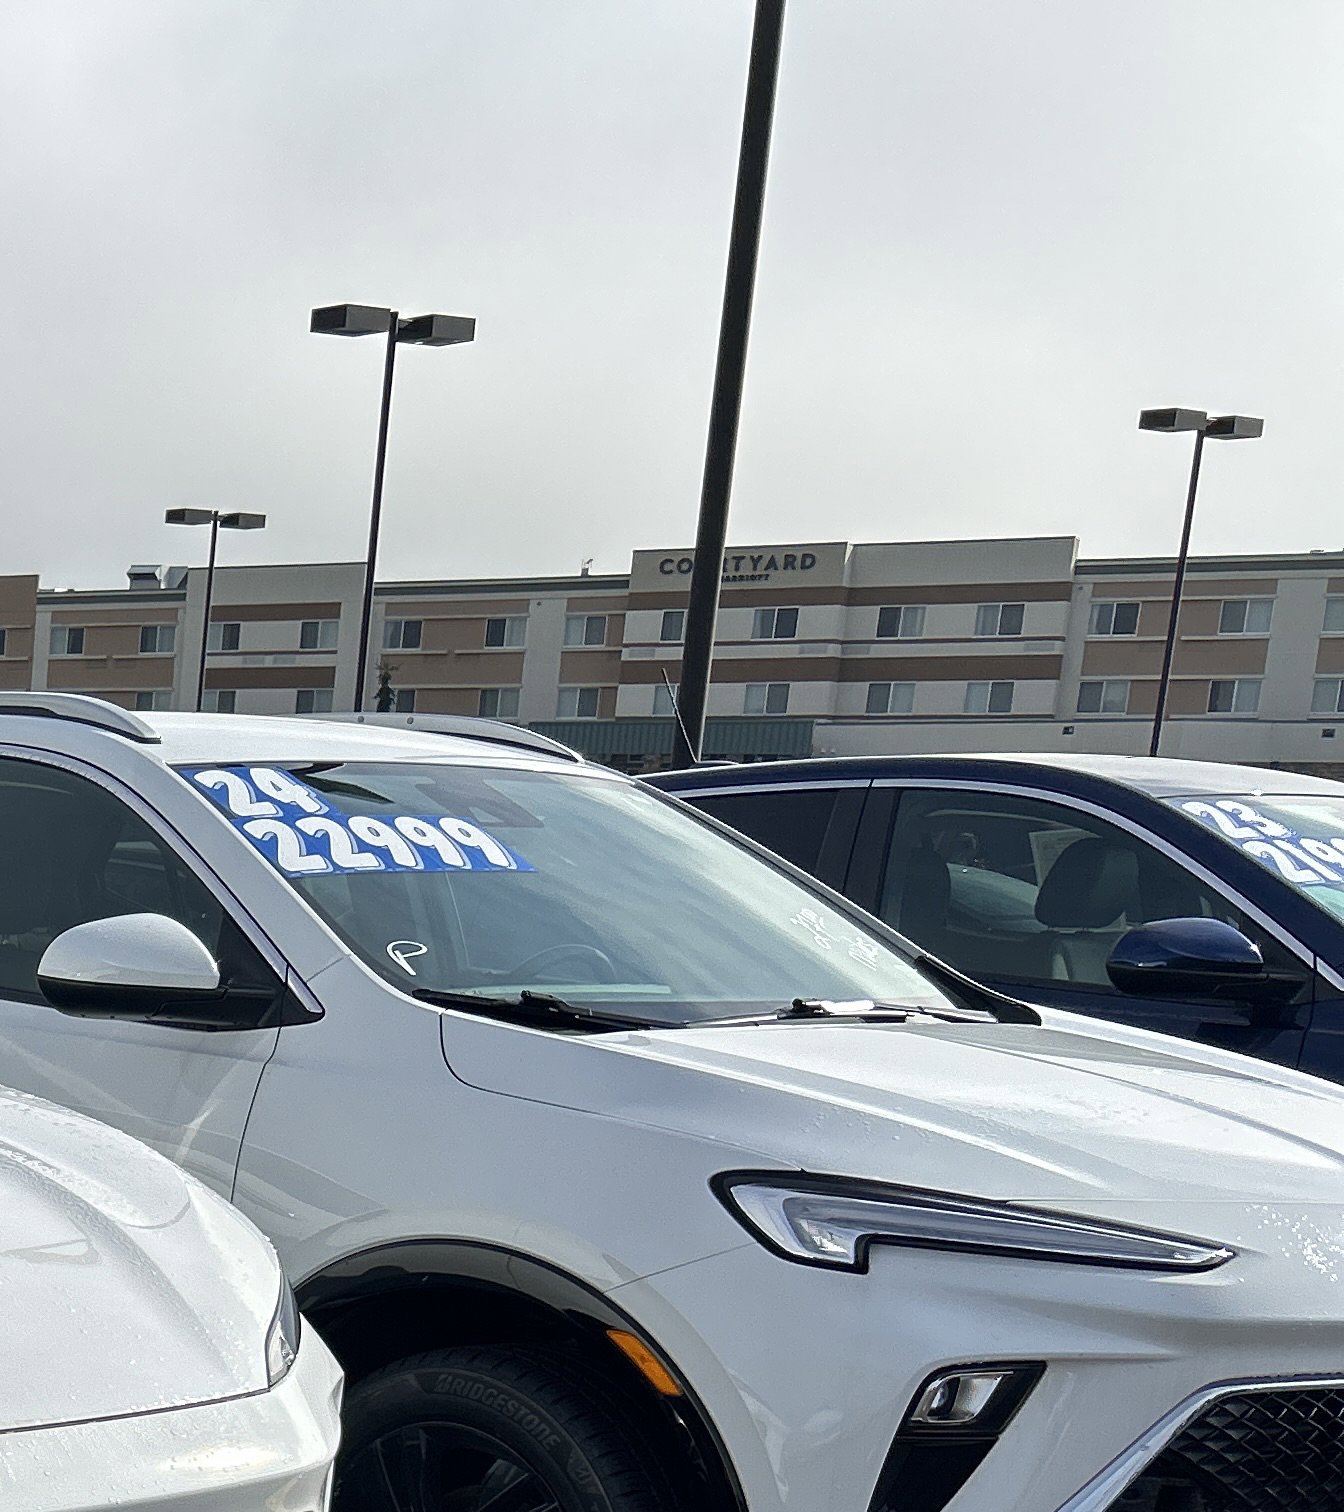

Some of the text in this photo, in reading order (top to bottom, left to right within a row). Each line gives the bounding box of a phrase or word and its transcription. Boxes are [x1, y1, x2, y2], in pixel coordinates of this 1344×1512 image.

[659, 553, 817, 574] COTYARD
[193, 767, 330, 818] 24
[242, 816, 518, 874] 22999
[1181, 800, 1298, 840] 23
[433, 1373, 561, 1451] BRIDGESTONE
